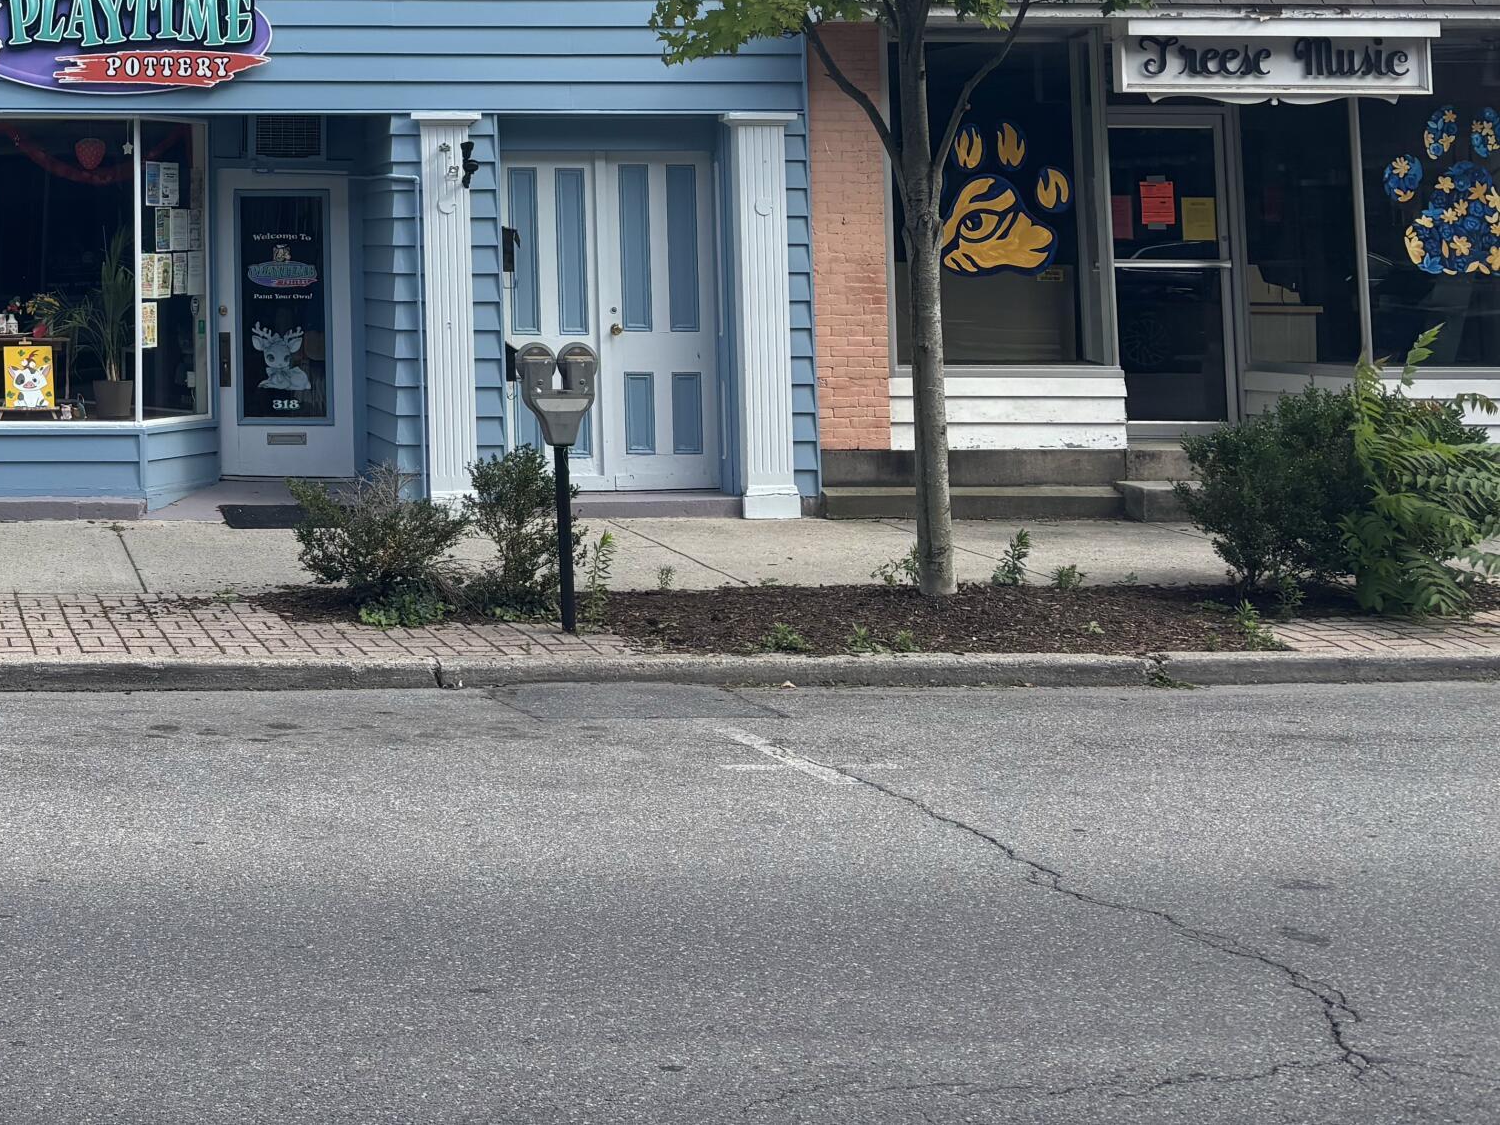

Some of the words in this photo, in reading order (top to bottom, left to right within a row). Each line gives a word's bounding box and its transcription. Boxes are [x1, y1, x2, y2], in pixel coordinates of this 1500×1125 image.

[1138, 36, 1273, 76] Treese
[1294, 36, 1410, 77] Music
[106, 55, 232, 78] POTTERY
[252, 232, 298, 241] Welcome
[299, 233, 312, 241] To
[292, 292, 313, 300] Own!
[272, 399, 300, 410] 318
